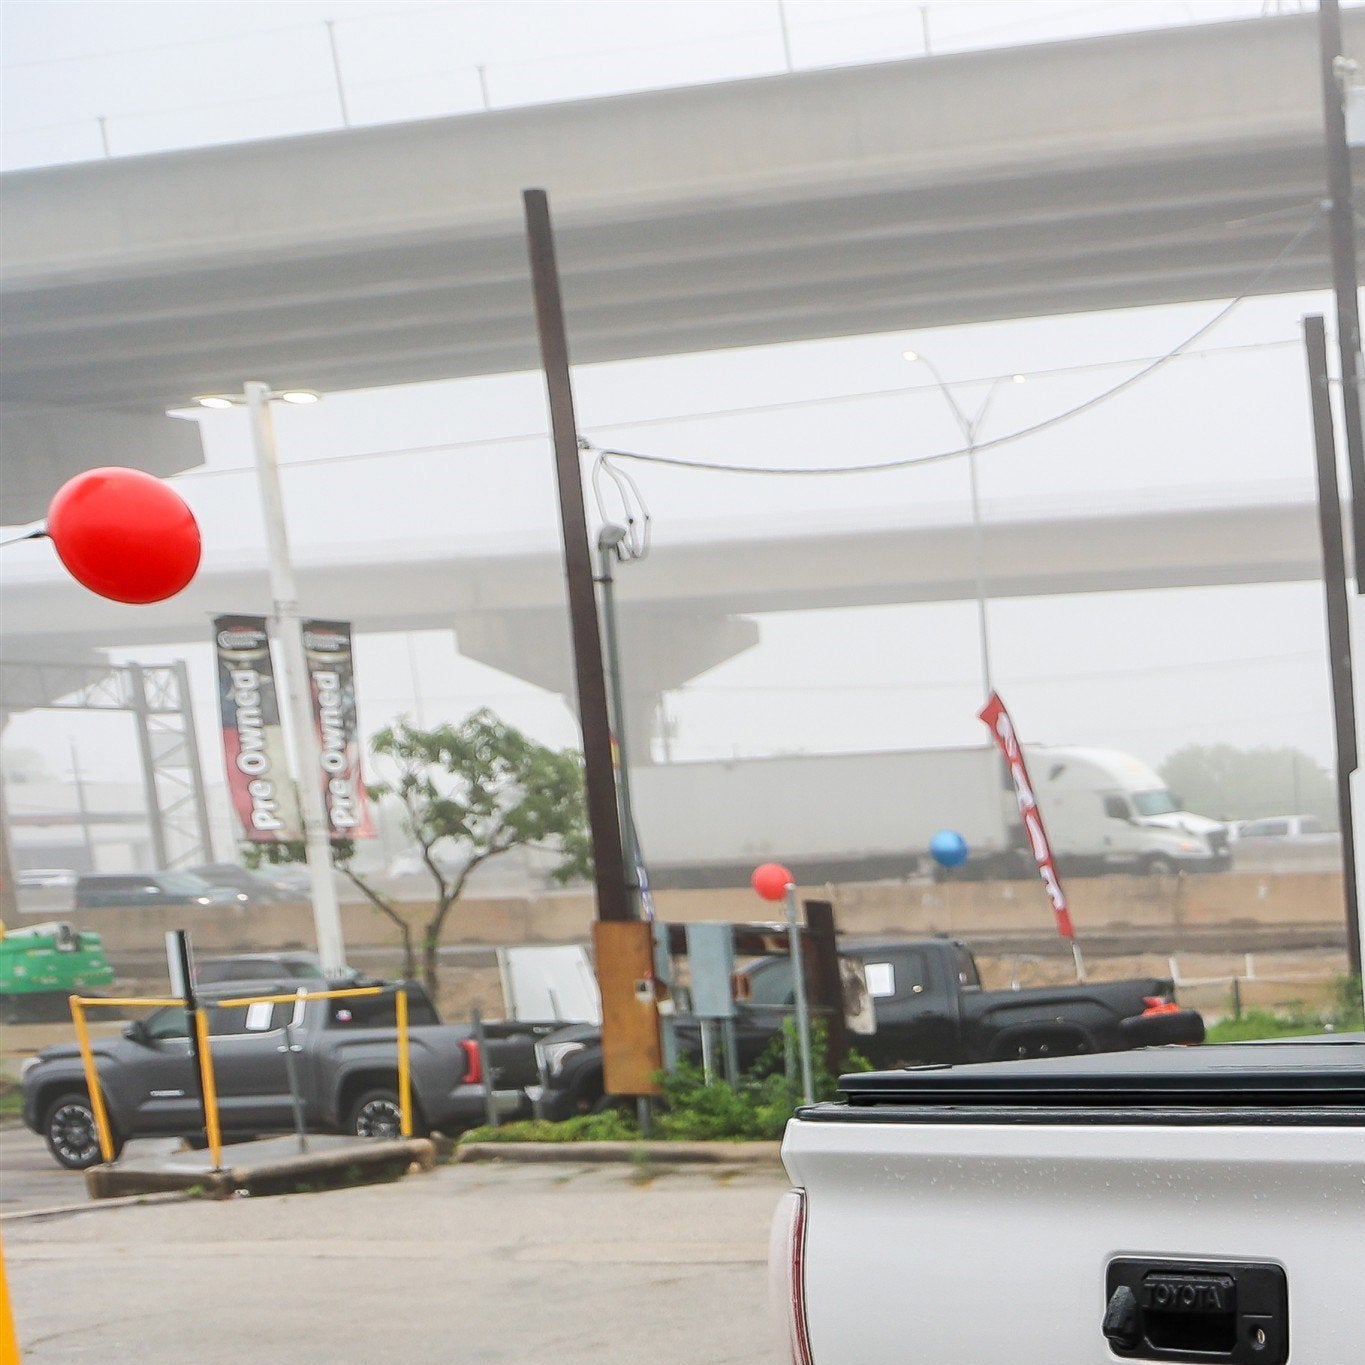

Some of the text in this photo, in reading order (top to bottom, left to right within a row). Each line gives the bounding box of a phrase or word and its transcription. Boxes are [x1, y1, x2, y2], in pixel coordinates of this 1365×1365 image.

[230, 669, 270, 776] Owned
[312, 671, 347, 774] Owned
[248, 779, 285, 830] Pre
[329, 778, 359, 829] Pre
[1142, 1283, 1222, 1311] TOYOTA
